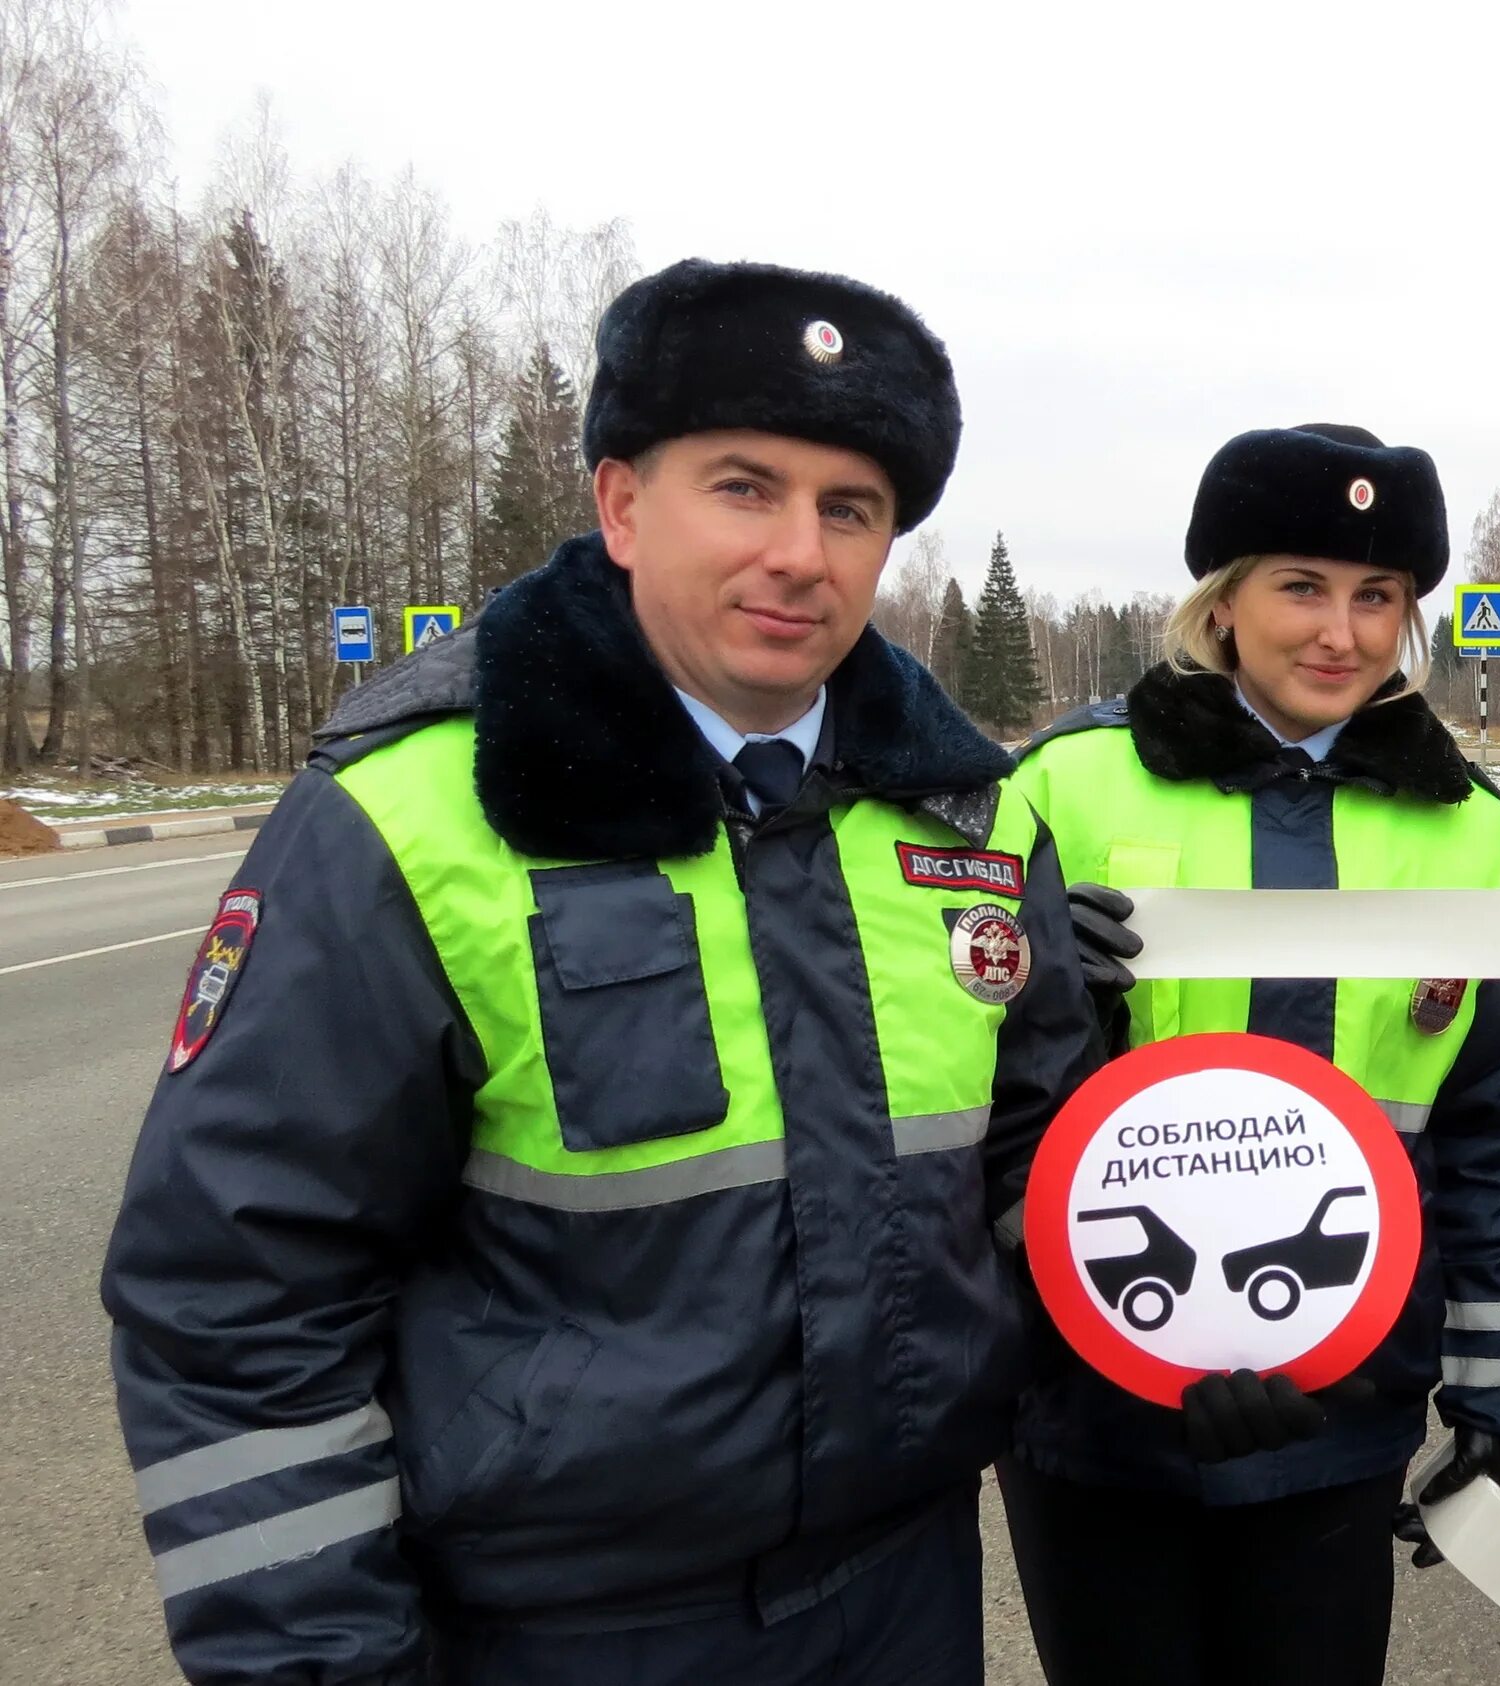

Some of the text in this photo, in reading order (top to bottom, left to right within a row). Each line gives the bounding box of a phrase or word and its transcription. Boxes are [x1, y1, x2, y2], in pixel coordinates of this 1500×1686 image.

[982, 965, 1010, 981] ДПС
[1117, 1108, 1306, 1149] СОБЛЮДАЙ
[1101, 1142, 1327, 1190] ДИСТАНЦИЮ!
